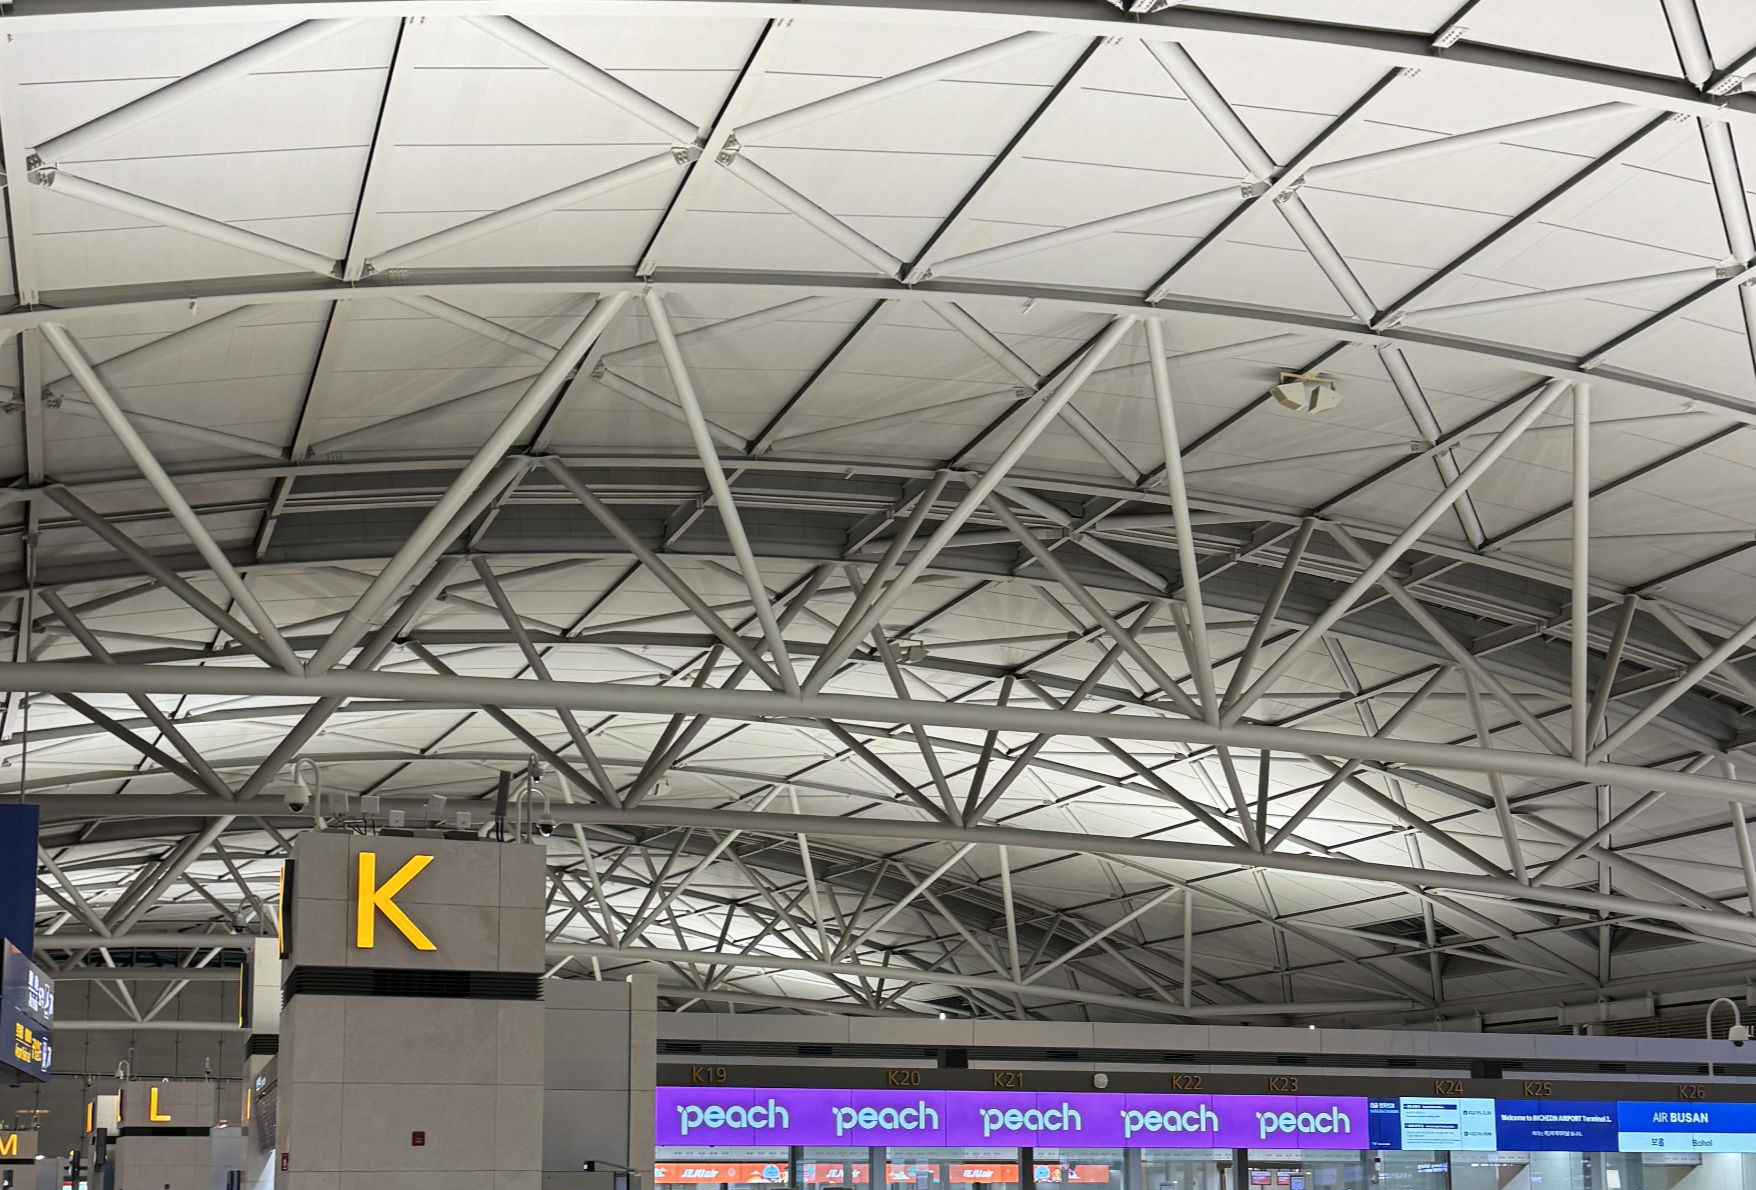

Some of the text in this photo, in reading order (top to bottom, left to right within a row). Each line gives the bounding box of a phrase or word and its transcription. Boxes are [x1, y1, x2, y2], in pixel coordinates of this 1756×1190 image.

[356, 851, 436, 951] K
[692, 1066, 727, 1084] K19
[887, 1070, 921, 1086] K20
[993, 1072, 1024, 1088] K21
[1171, 1075, 1203, 1091] K22
[1268, 1077, 1299, 1093] K23
[1434, 1080, 1465, 1096] K24
[1523, 1081, 1553, 1097] K25
[1678, 1084, 1706, 1100] K26
[150, 1086, 173, 1123] L
[676, 1098, 789, 1136] peach
[831, 1100, 939, 1137] peach
[979, 1102, 1082, 1137] peach
[1120, 1104, 1219, 1139] peach
[1256, 1106, 1351, 1140] peach
[1652, 1111, 1709, 1123] AIR BUSAN
[0, 1133, 18, 1156] M
